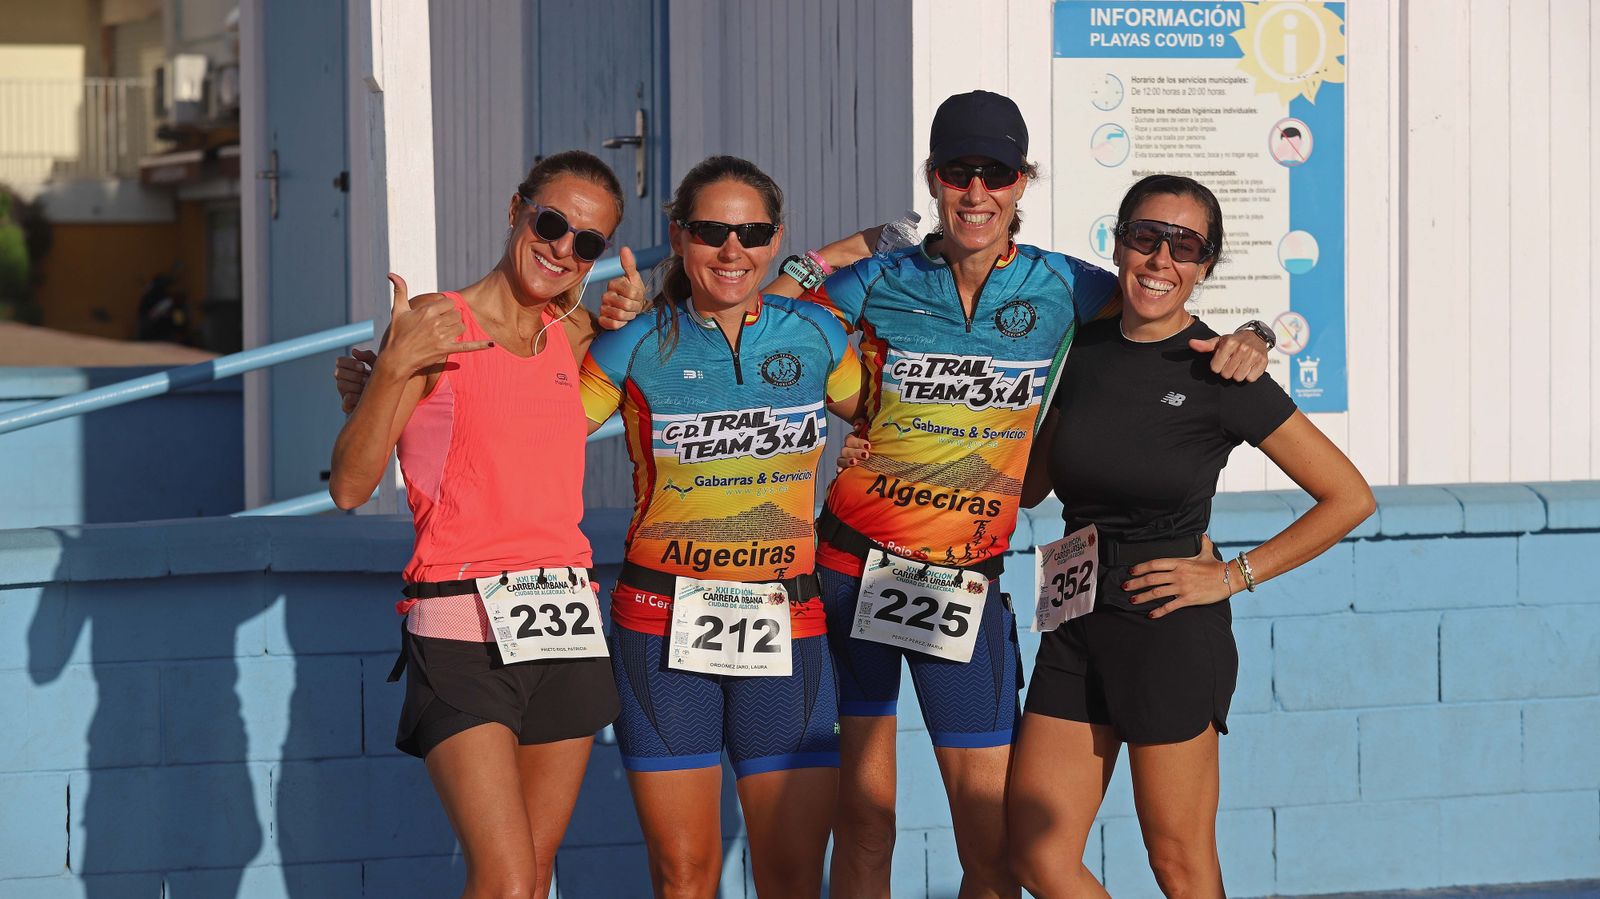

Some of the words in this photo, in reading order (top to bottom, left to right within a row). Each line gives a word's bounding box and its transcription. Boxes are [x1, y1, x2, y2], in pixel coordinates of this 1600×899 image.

[1090, 4, 1241, 27] INFORMACIÓN
[1090, 33, 1150, 47] PLAYAS
[1154, 33, 1203, 47] COVID
[1208, 34, 1225, 47] 19
[1131, 76, 1155, 84] Horario
[1157, 76, 1165, 84] de
[1166, 76, 1176, 84] los
[1178, 76, 1207, 84] servicios
[1208, 76, 1249, 85] municipales:
[1131, 88, 1141, 96] De
[1143, 88, 1160, 96] 12:00
[1162, 88, 1180, 96] horas
[1188, 88, 1206, 96] 20:00
[924, 357, 988, 379] TRAIL
[904, 381, 971, 401] TEAM
[701, 411, 770, 437] TRAIL
[912, 417, 965, 438] Gabarras
[968, 426, 979, 438] &
[982, 427, 1027, 440] Servicios
[682, 435, 754, 460] TEAM
[694, 475, 753, 488] Gabarras
[756, 472, 767, 485] &
[771, 470, 813, 483] Servicios
[866, 474, 1002, 518] Algeciras
[660, 540, 796, 573] Algeciras
[506, 582, 541, 593] CARRERA
[541, 581, 569, 590] URBANA
[715, 586, 729, 594] XXI
[1051, 560, 1094, 608] 352
[703, 592, 740, 603] CARRERA
[510, 602, 596, 640] 232
[874, 588, 972, 638] 225
[691, 615, 781, 653] 212
